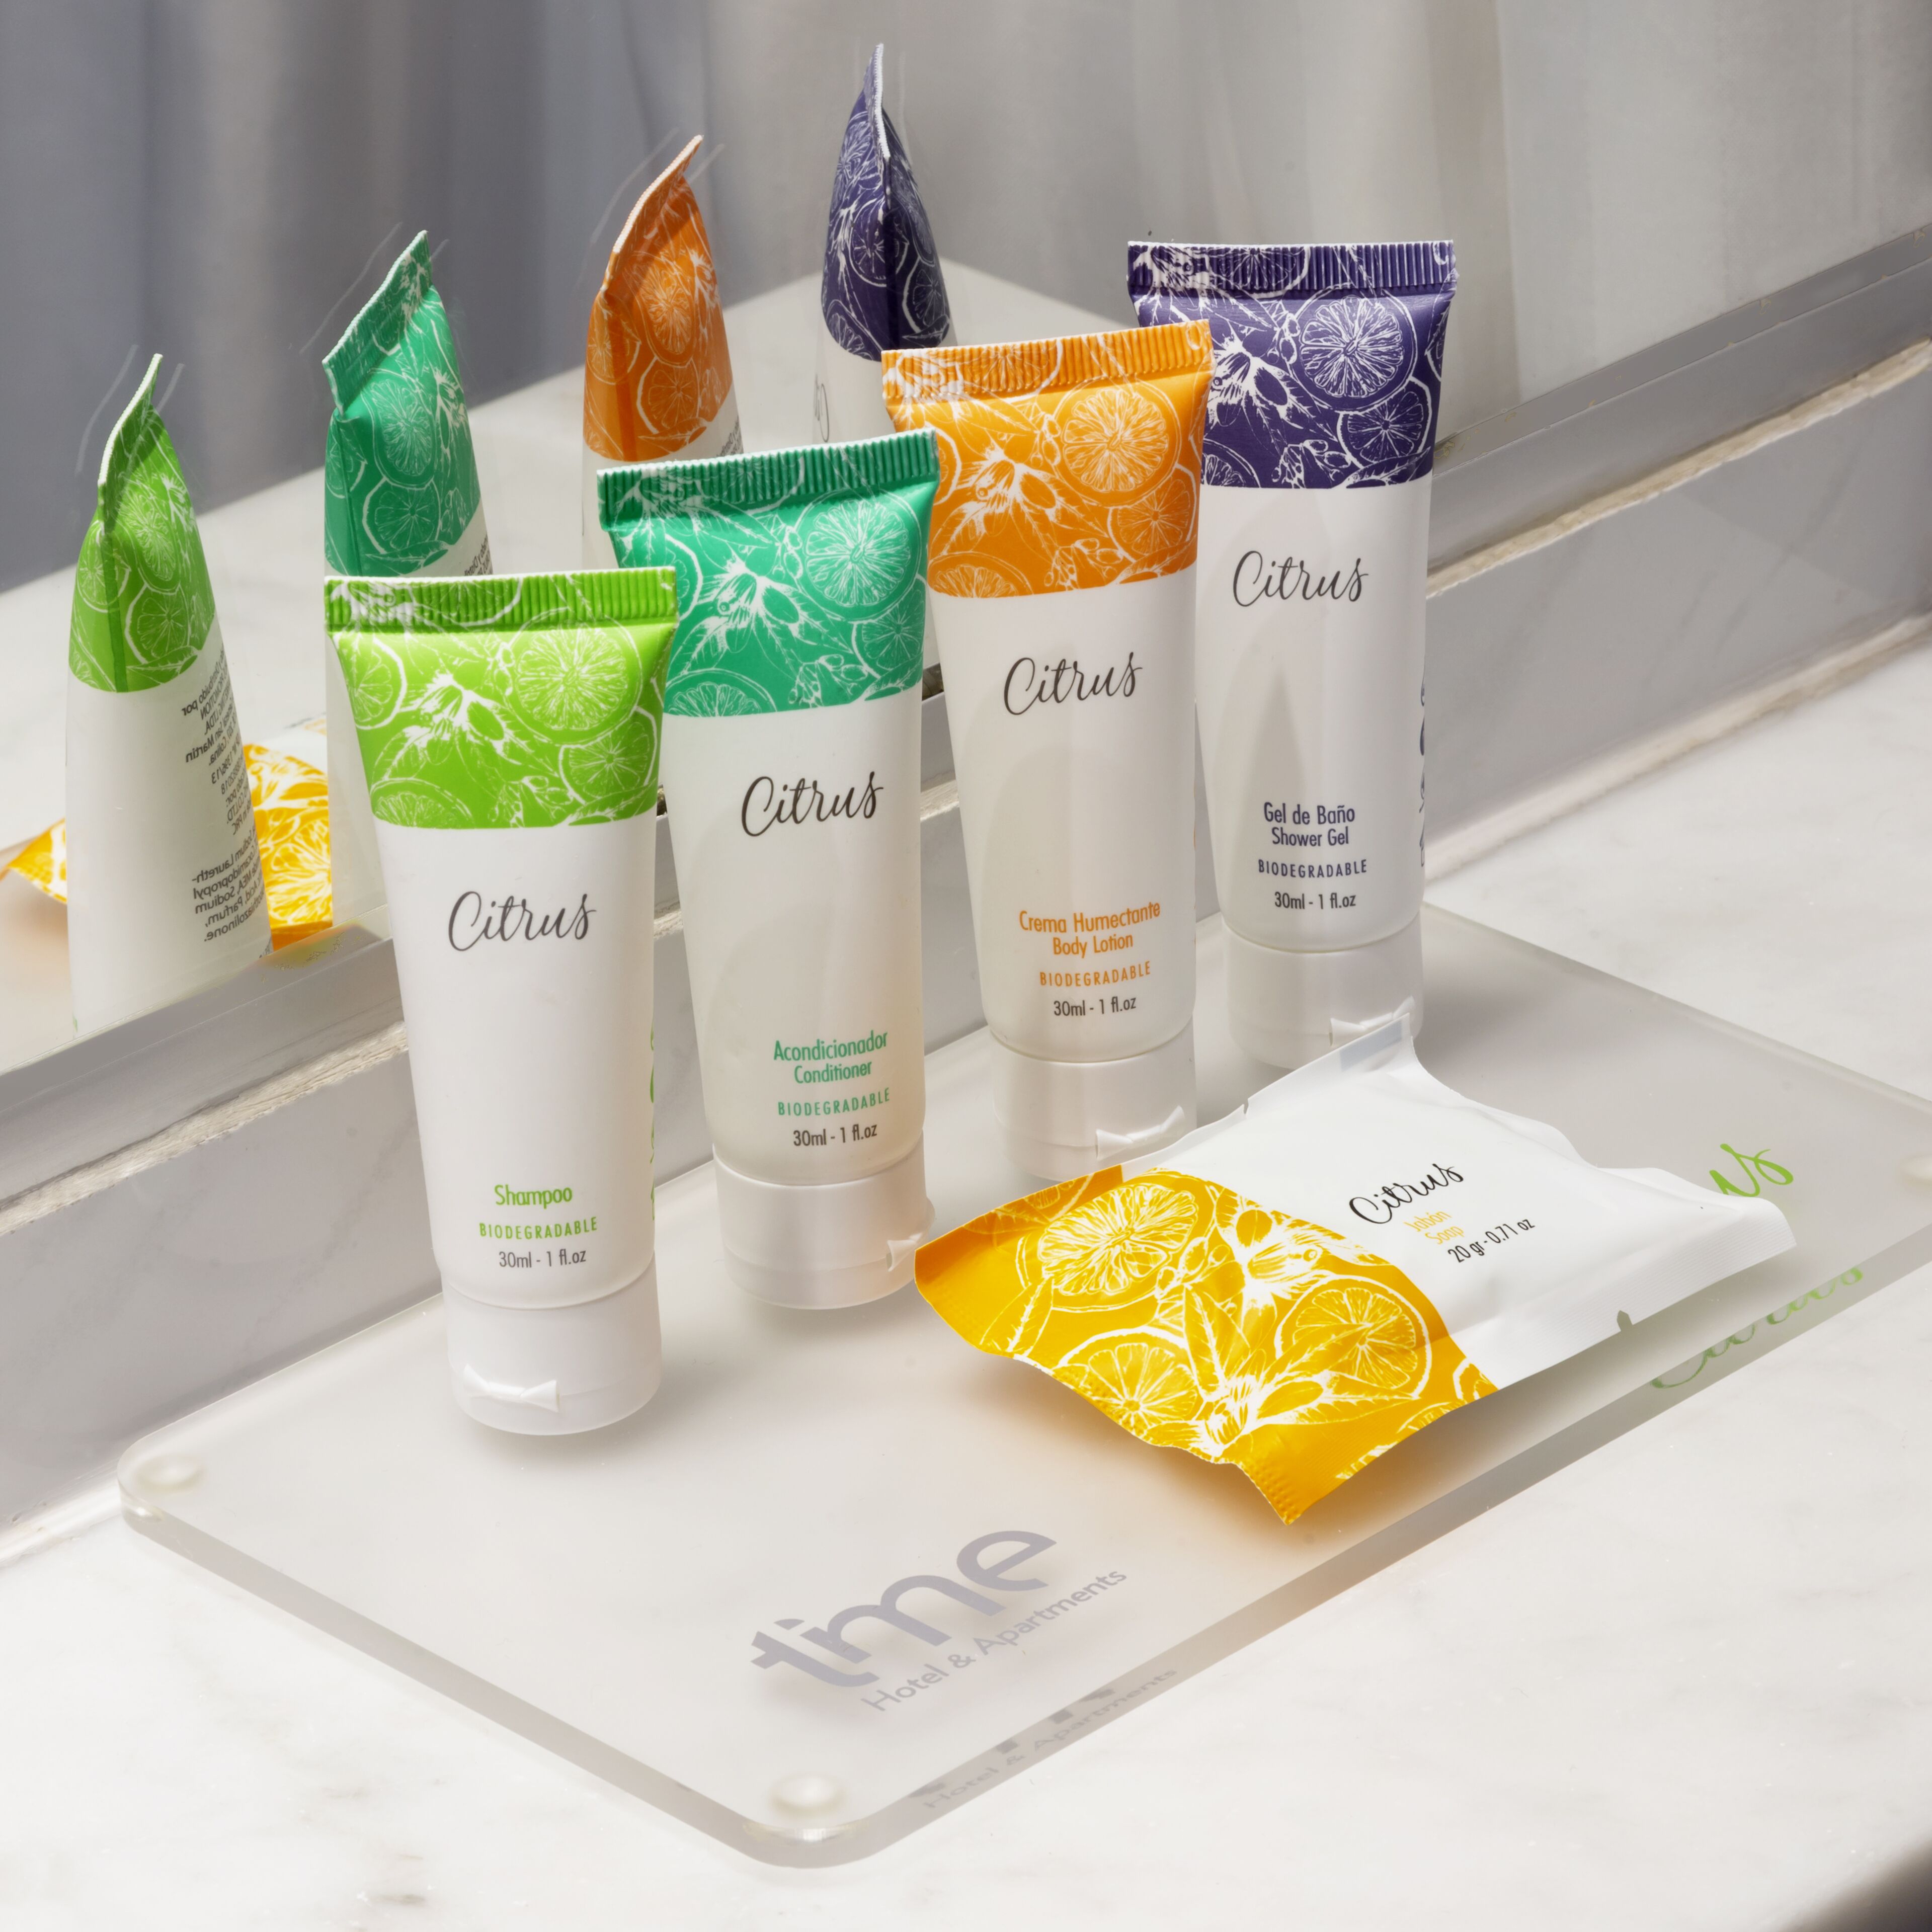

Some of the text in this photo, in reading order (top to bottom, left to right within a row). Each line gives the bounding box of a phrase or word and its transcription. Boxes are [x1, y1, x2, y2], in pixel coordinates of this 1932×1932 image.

[1233, 550, 1369, 607] Citrus
[1004, 652, 1143, 715] Citrus
[742, 771, 884, 837] Citrus
[1263, 801, 1355, 825] Gel de Baño
[1271, 826, 1349, 846] Shower Gel
[1258, 859, 1366, 878] BIODEGRADABLE
[1275, 892, 1305, 909] 30ml
[1318, 894, 1323, 910] 1
[1330, 892, 1356, 908] fl.oz
[448, 891, 597, 951] Citrus
[1019, 902, 1160, 933] Crema Humectante
[1053, 934, 1133, 958] Body Lotion
[1039, 960, 1150, 987] BIODEGRADABLE
[1054, 1000, 1085, 1016] 30ml
[1099, 999, 1104, 1014] 1
[1111, 996, 1136, 1013] fl.oz
[773, 1029, 888, 1061] Acondicionador
[794, 1062, 872, 1084] Conditioner
[778, 1087, 890, 1116] BIODEGRADABLE
[793, 1129, 827, 1146] 30ml
[840, 1127, 846, 1143] 1
[852, 1124, 877, 1141] fl.oz
[495, 1184, 573, 1209] Shampoo
[1349, 1163, 1464, 1224] Citrus
[479, 1217, 597, 1240] BIODEGRADABLE
[1403, 1211, 1452, 1232] Jabón
[1425, 1226, 1465, 1245] Soap
[1447, 1245, 1472, 1263] 20
[1470, 1241, 1485, 1256] gr
[1485, 1224, 1518, 1244] 0.71
[1517, 1219, 1535, 1231] oz
[499, 1251, 532, 1268] 30ml
[546, 1251, 552, 1266] 1
[558, 1249, 586, 1265] fl.oz
[860, 1570, 1126, 1712] Hotel & Apartments
